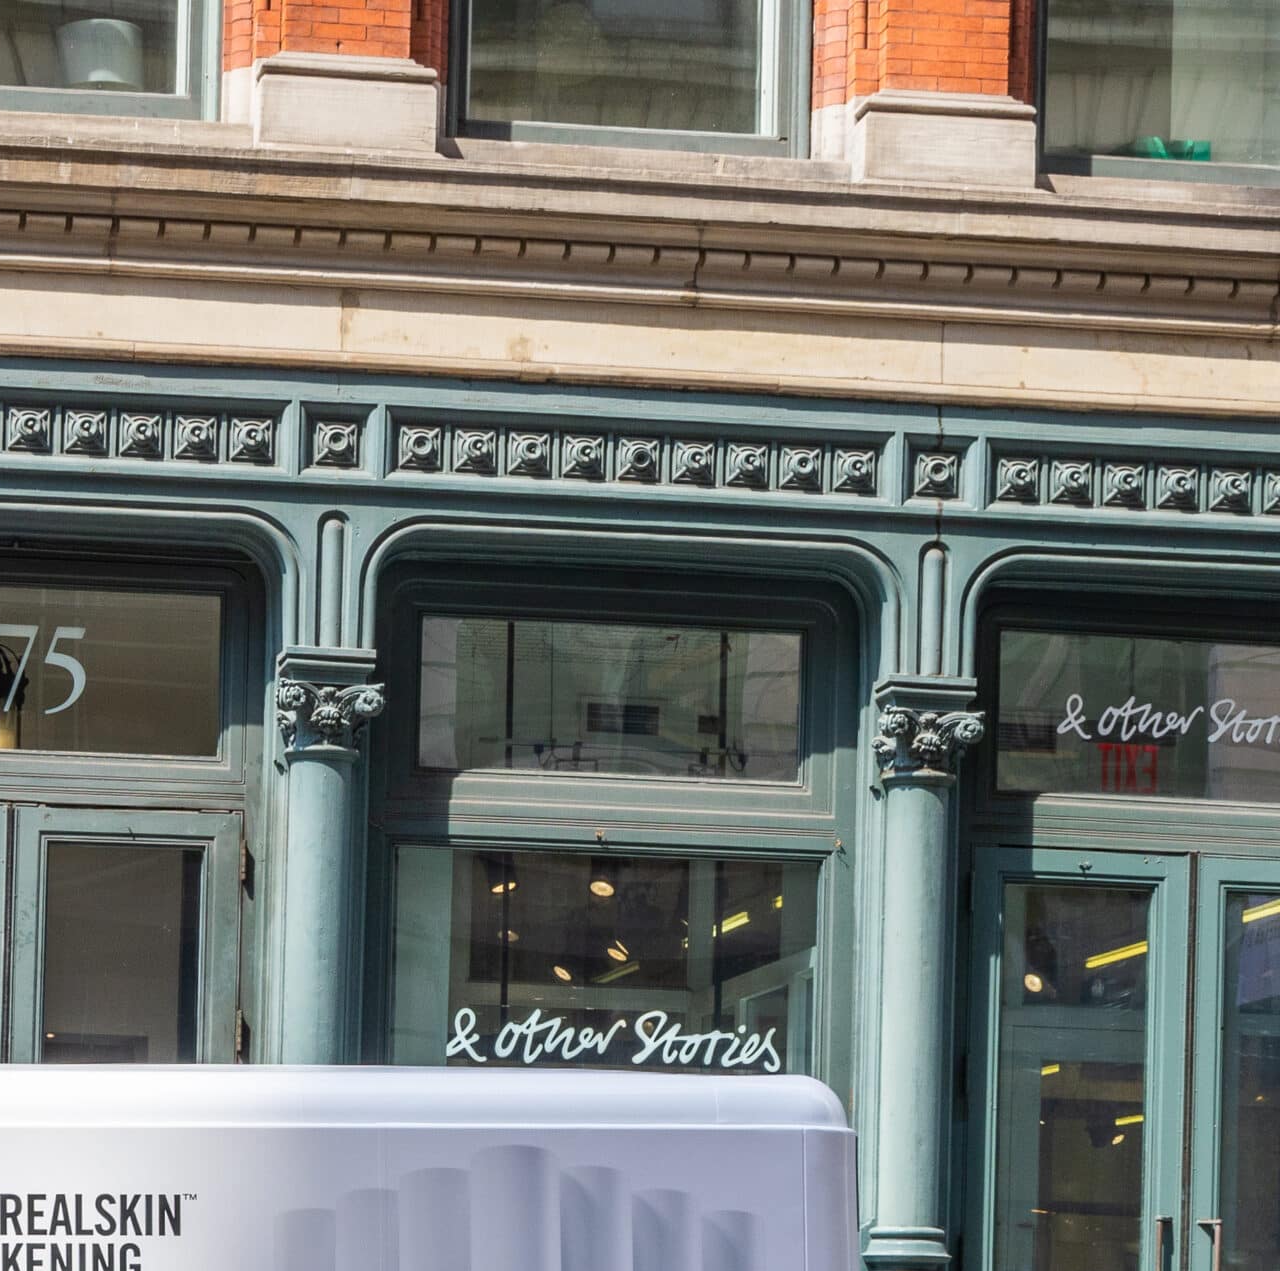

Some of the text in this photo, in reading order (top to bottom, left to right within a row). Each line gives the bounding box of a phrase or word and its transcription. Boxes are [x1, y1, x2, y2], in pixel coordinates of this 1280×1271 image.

[1056, 693, 1092, 739] &
[1097, 696, 1204, 742] other
[446, 1007, 781, 1073] & other Stories
